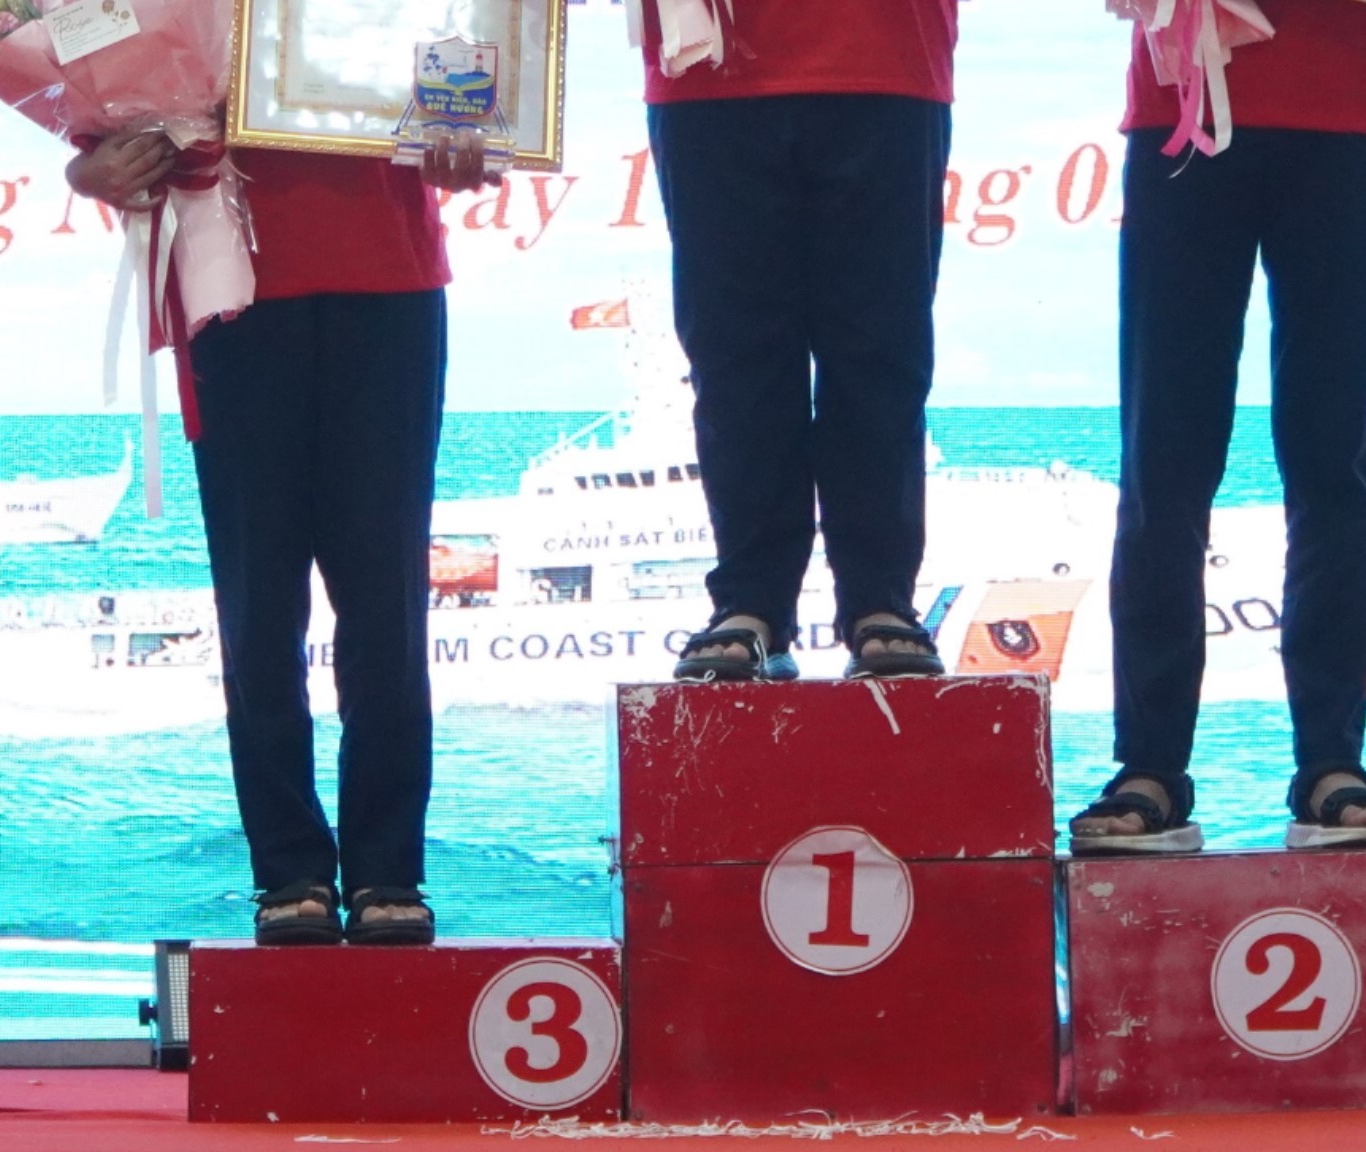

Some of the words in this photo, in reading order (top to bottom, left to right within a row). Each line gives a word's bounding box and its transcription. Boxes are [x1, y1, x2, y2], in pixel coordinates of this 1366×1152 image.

[489, 630, 645, 662] COAST
[806, 850, 871, 949] 1
[1245, 932, 1325, 1032] 2
[503, 981, 588, 1083] 3
